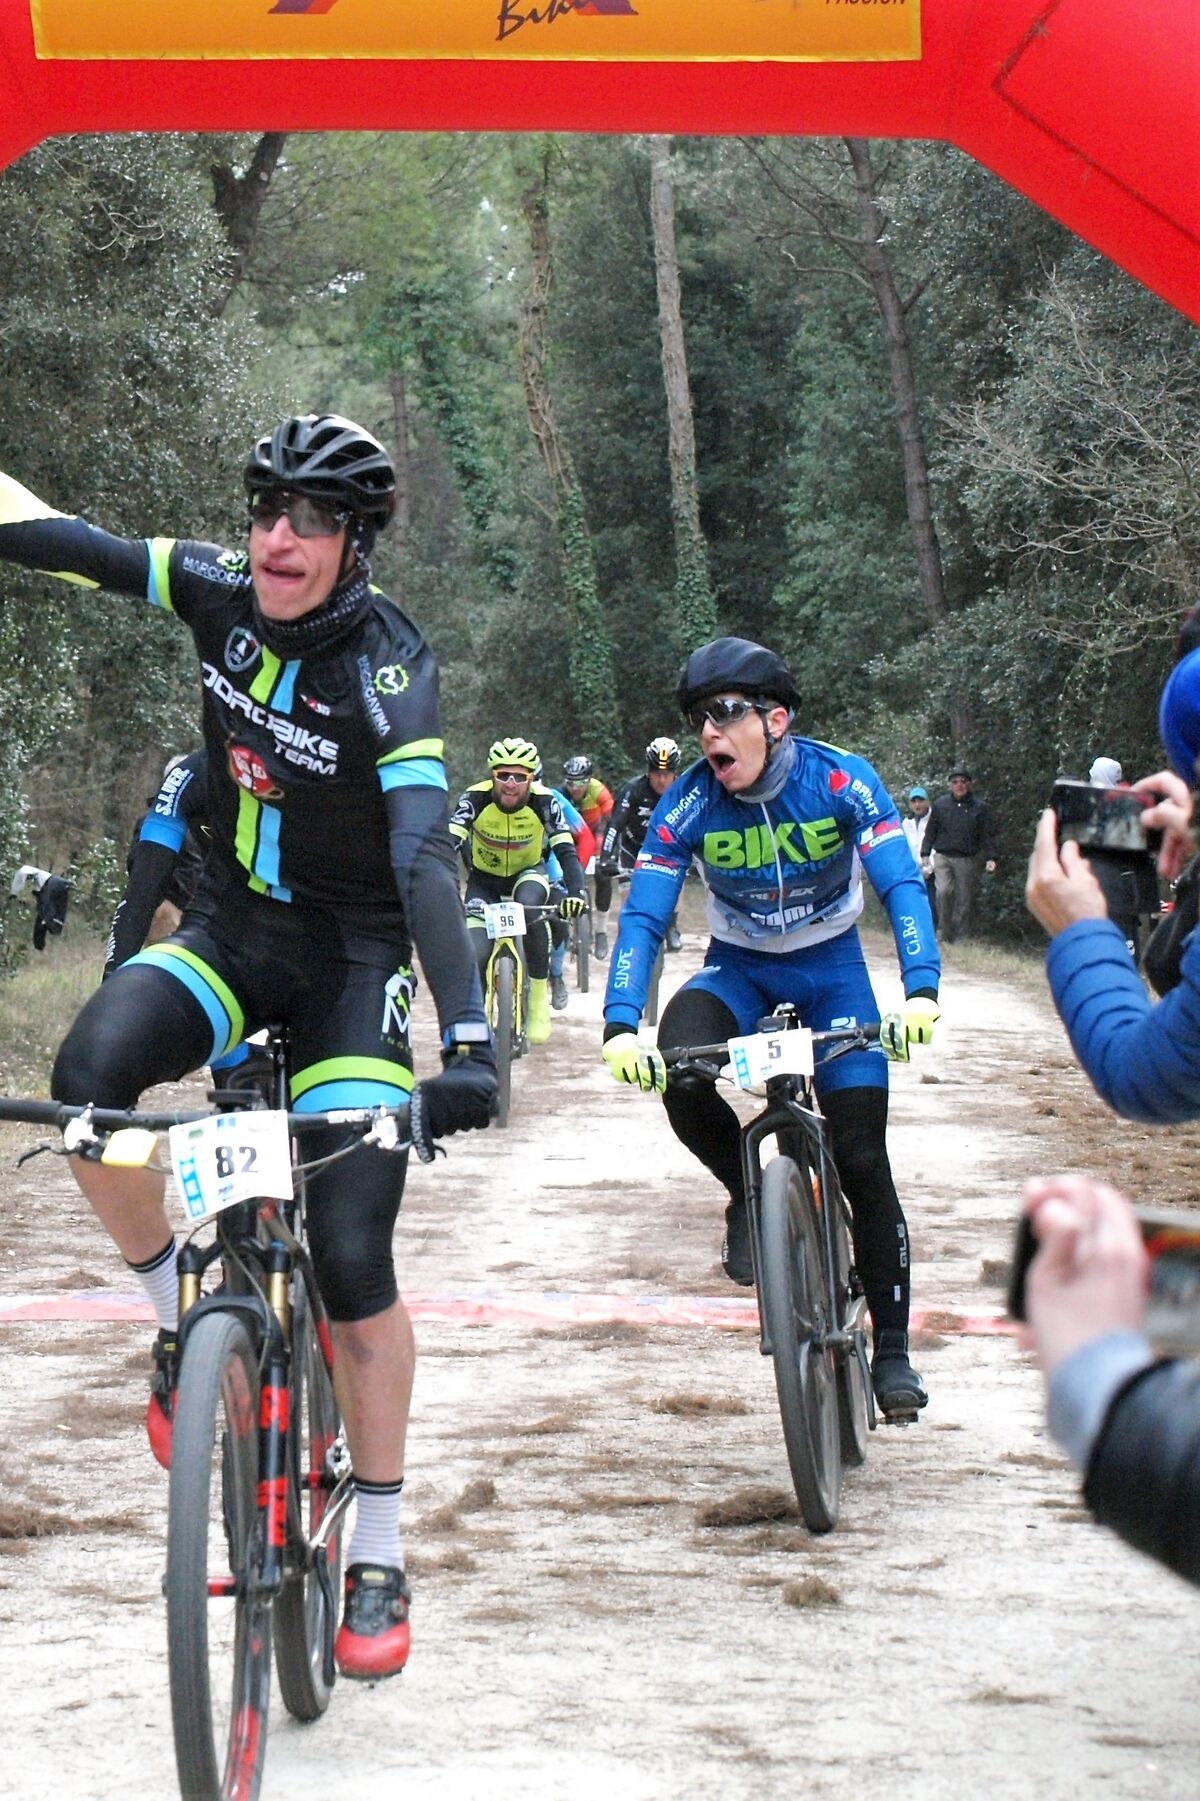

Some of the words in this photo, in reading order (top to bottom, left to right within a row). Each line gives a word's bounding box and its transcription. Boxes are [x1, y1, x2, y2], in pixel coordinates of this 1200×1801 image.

[274, 739, 338, 776] TEAM
[664, 786, 702, 825] BRIGHT
[703, 816, 844, 870] BIKE
[499, 915, 515, 927] 96
[767, 1039, 782, 1060] 5
[214, 1145, 260, 1179] 82
